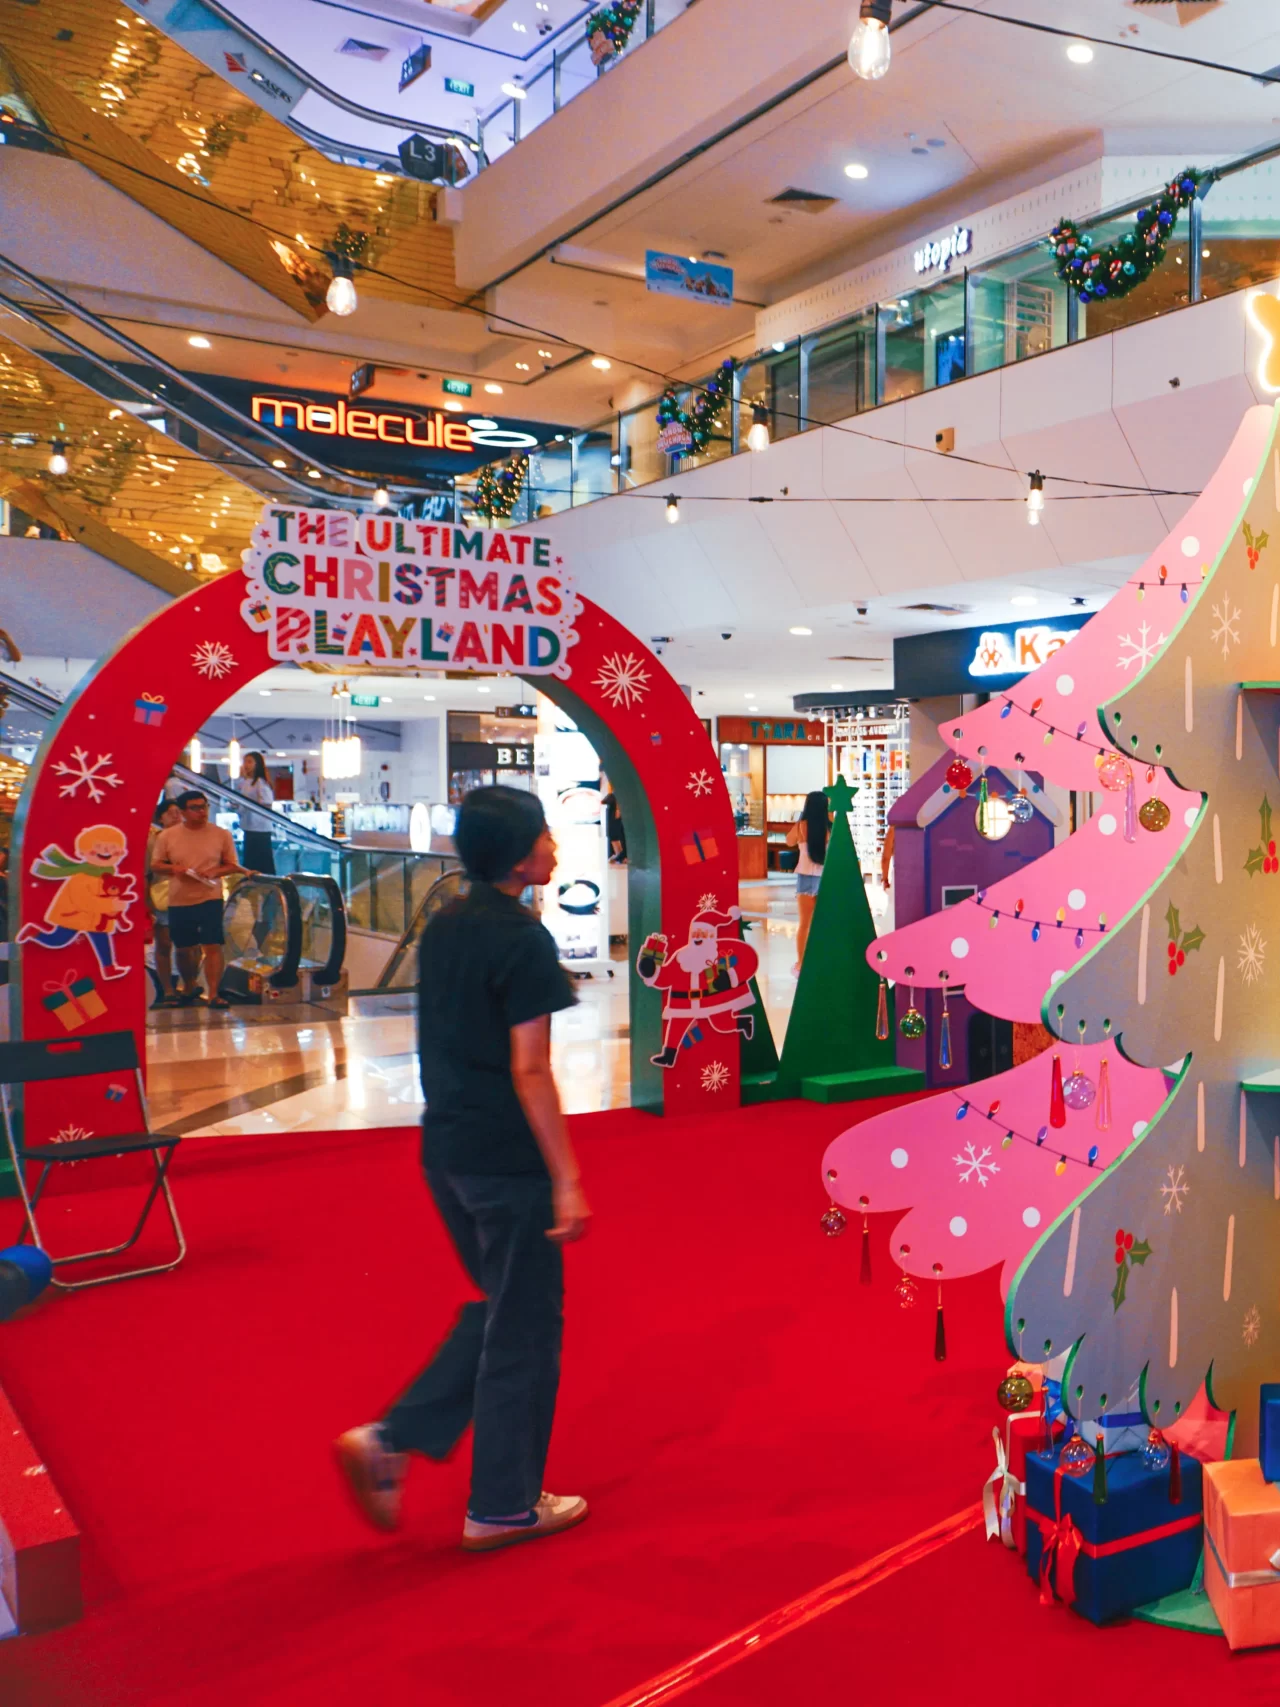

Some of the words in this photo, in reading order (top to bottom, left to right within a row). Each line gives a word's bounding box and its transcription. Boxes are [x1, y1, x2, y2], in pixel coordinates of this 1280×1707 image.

[409, 141, 437, 162] L3
[913, 225, 972, 273] utopia
[252, 397, 474, 452] malecule
[269, 509, 350, 548] THE
[365, 518, 551, 568] ULTIMATE
[262, 551, 563, 617] CHRISTMAS
[275, 606, 561, 668] PLAYLAND
[497, 748, 535, 765] BE
